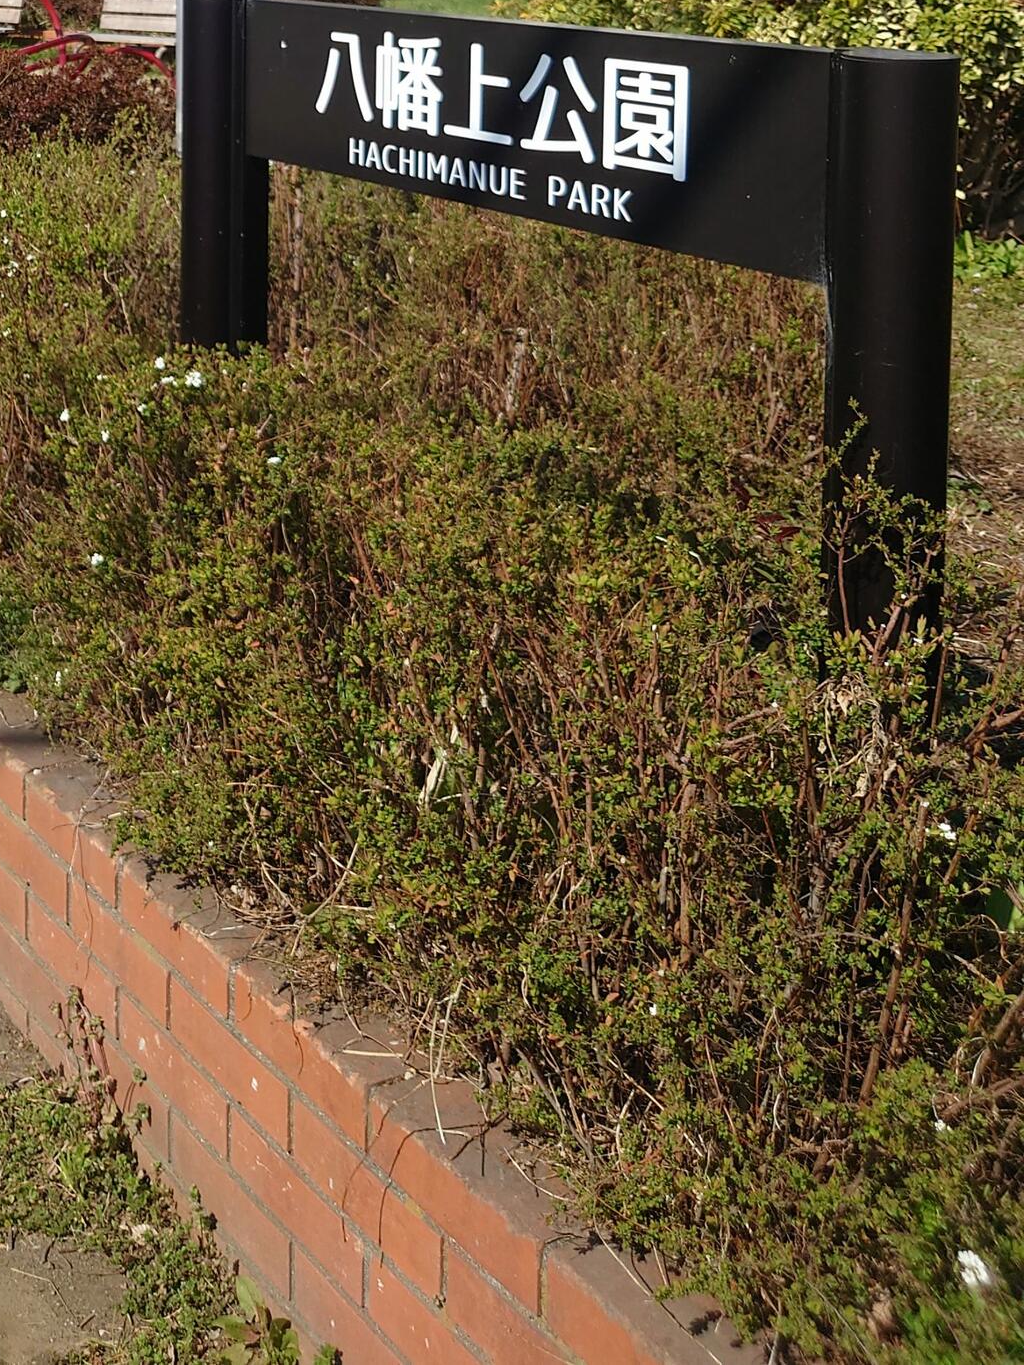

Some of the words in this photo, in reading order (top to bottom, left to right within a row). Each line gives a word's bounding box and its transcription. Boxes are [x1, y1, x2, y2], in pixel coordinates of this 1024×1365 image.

[315, 31, 689, 182] 八幡上公園
[348, 137, 527, 201] HACHIMANUE
[547, 175, 633, 223] PARK
